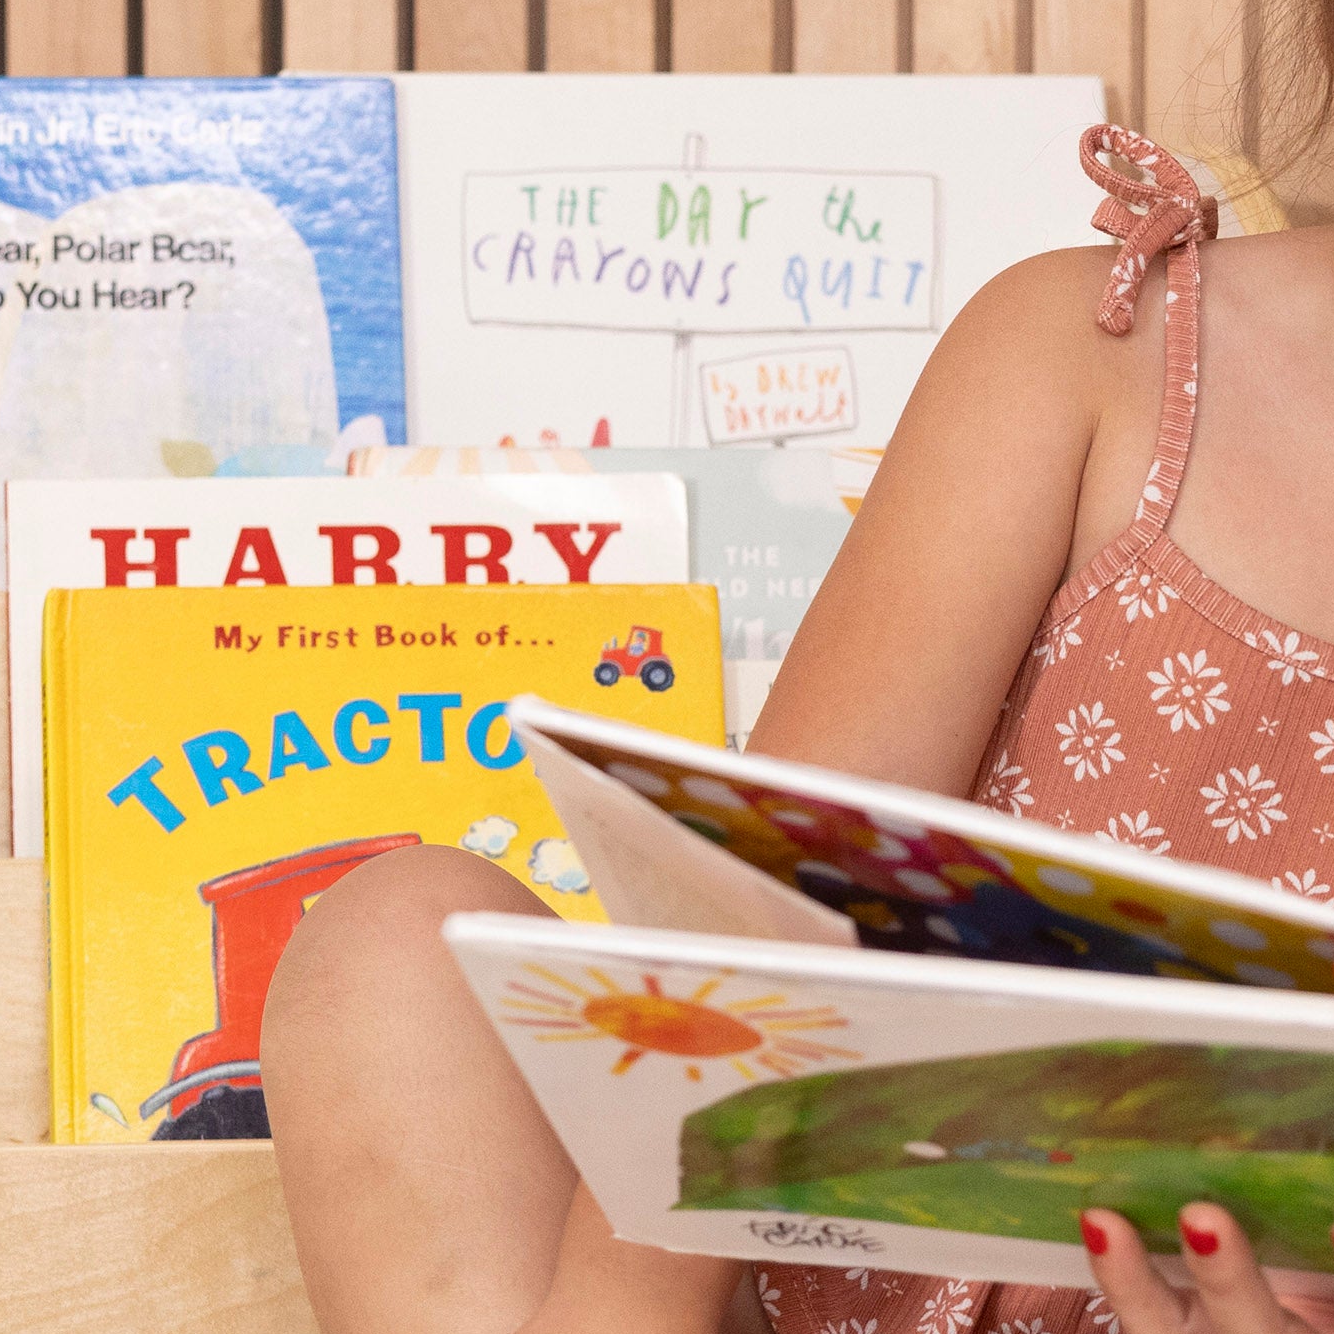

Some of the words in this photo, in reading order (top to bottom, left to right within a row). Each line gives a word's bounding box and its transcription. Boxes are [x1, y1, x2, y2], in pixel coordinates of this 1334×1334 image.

[520, 184, 604, 227] THE
[656, 181, 767, 246] DAY
[823, 185, 884, 243] the
[52, 234, 141, 263] Polar
[472, 230, 737, 305] CRAYONS
[783, 254, 926, 324] QUIT
[16, 281, 82, 310] You
[92, 281, 196, 310] Hear?
[88, 521, 624, 586] HARRY
[723, 544, 781, 568] THE
[213, 624, 264, 654] My
[276, 623, 360, 650] First
[373, 621, 459, 649] Book
